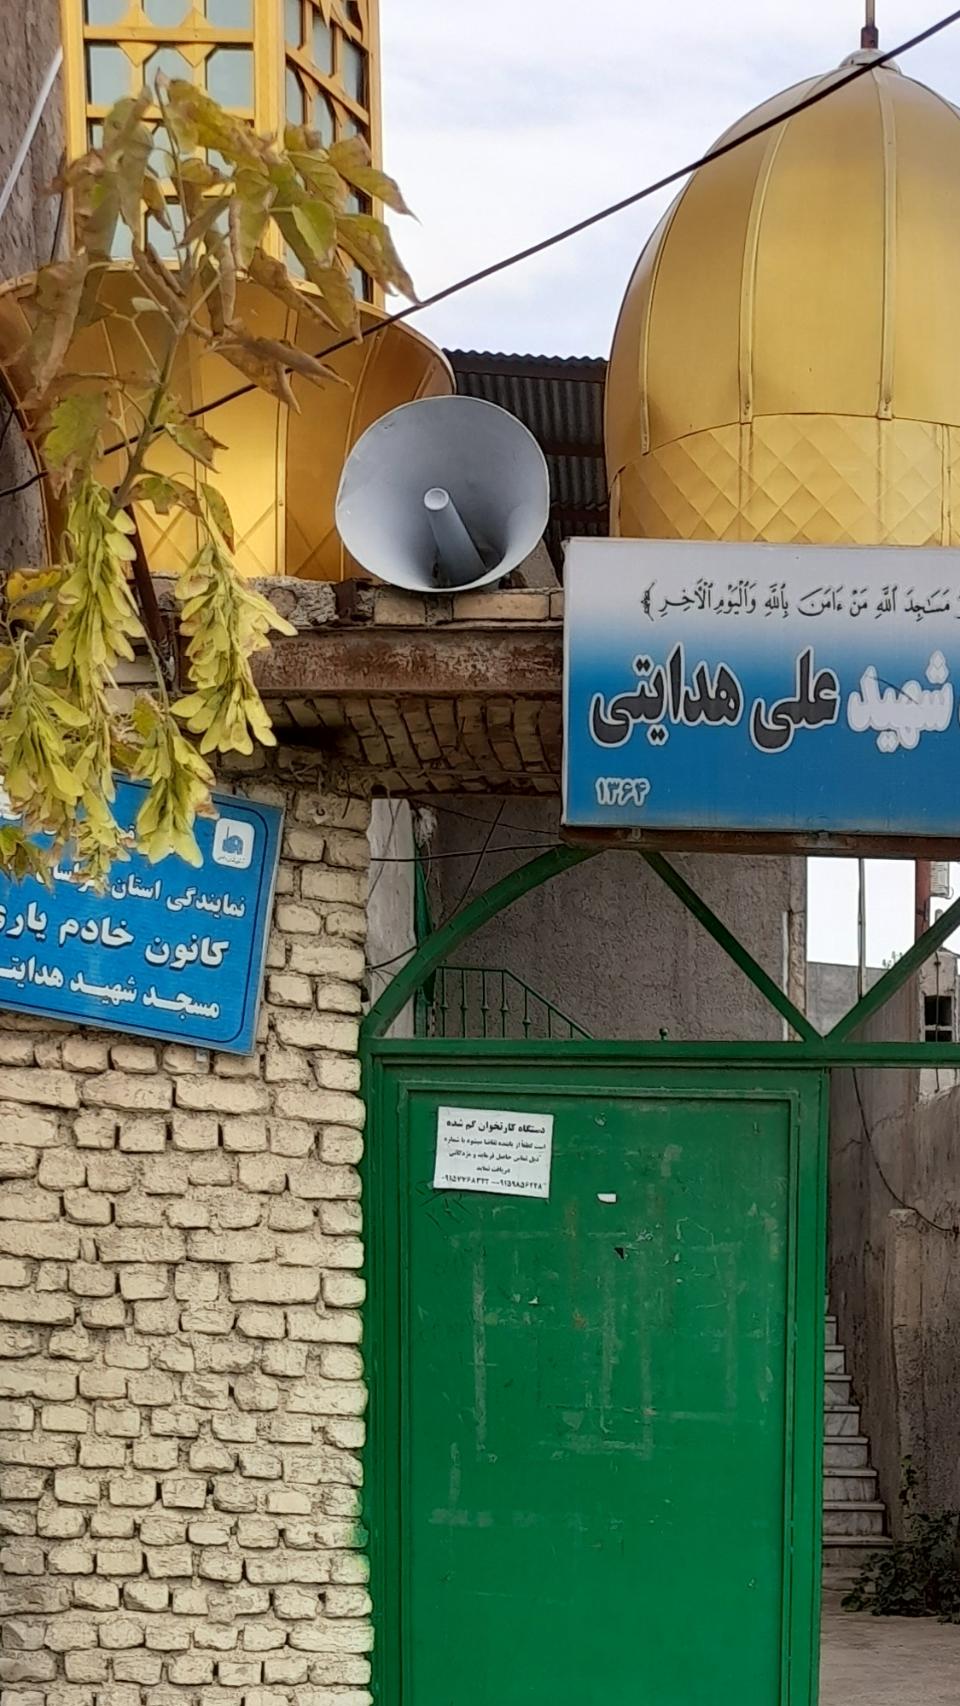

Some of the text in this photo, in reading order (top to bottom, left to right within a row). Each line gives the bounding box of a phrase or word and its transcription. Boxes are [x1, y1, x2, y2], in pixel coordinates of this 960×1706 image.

[589, 641, 744, 748] هدایتی
[750, 645, 841, 753] علی
[847, 649, 954, 753] شهید
[595, 777, 651, 807] ۱۳۶۴
[111, 873, 162, 900] استان
[166, 887, 246, 919] نمایندگی
[59, 916, 135, 948] خادم
[145, 933, 230, 969] کانون
[0, 955, 220, 1021] مسجد شهید هدایت
[517, 1123, 546, 1135] دستگاه
